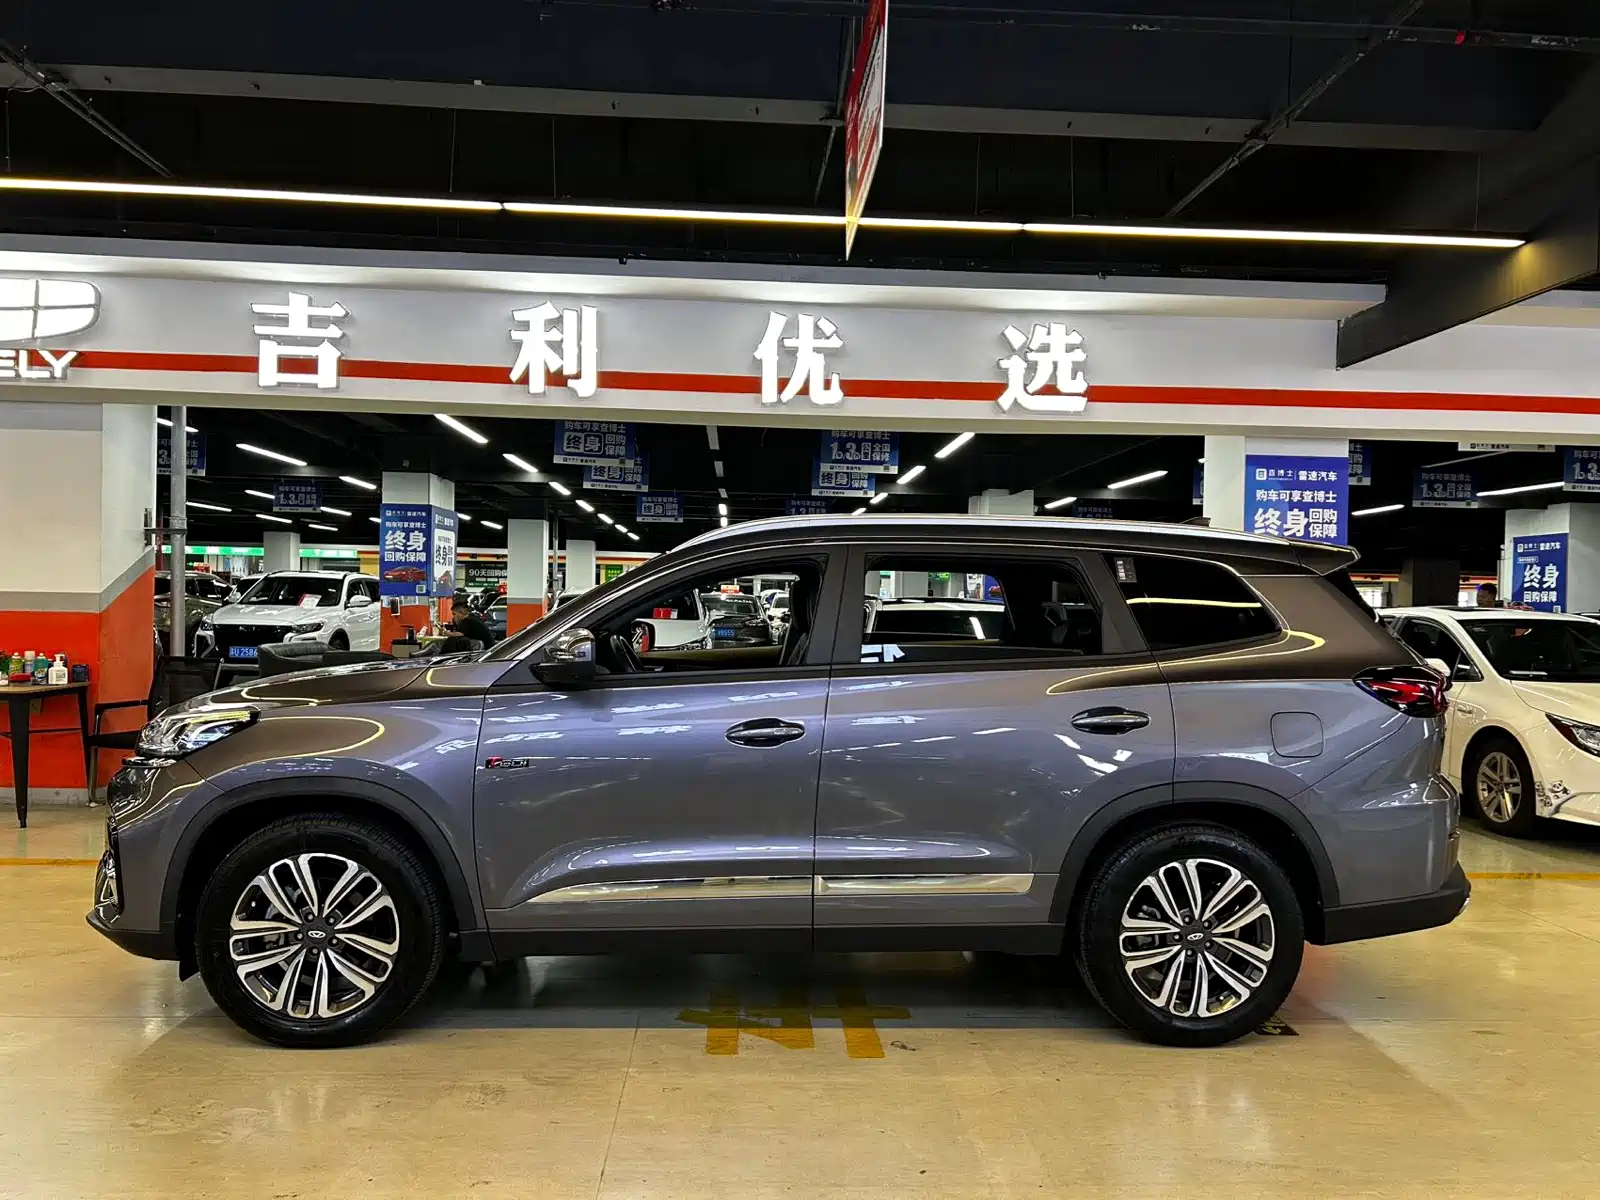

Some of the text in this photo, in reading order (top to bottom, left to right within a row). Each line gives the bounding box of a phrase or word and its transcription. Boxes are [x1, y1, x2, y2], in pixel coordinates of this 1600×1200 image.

[251, 291, 1089, 414] 吉利优选
[564, 432, 604, 454] 终身
[1298, 471, 1337, 481] 雷速汽车
[1256, 489, 1337, 502] 购车可享查博士
[1254, 508, 1308, 537] 终身
[1309, 509, 1337, 523] 回购
[1309, 524, 1337, 538] 保障
[385, 530, 426, 551] 终身
[385, 552, 426, 562] 回购保障
[1524, 563, 1559, 588] 终身
[1524, 591, 1557, 602] 回购保障
